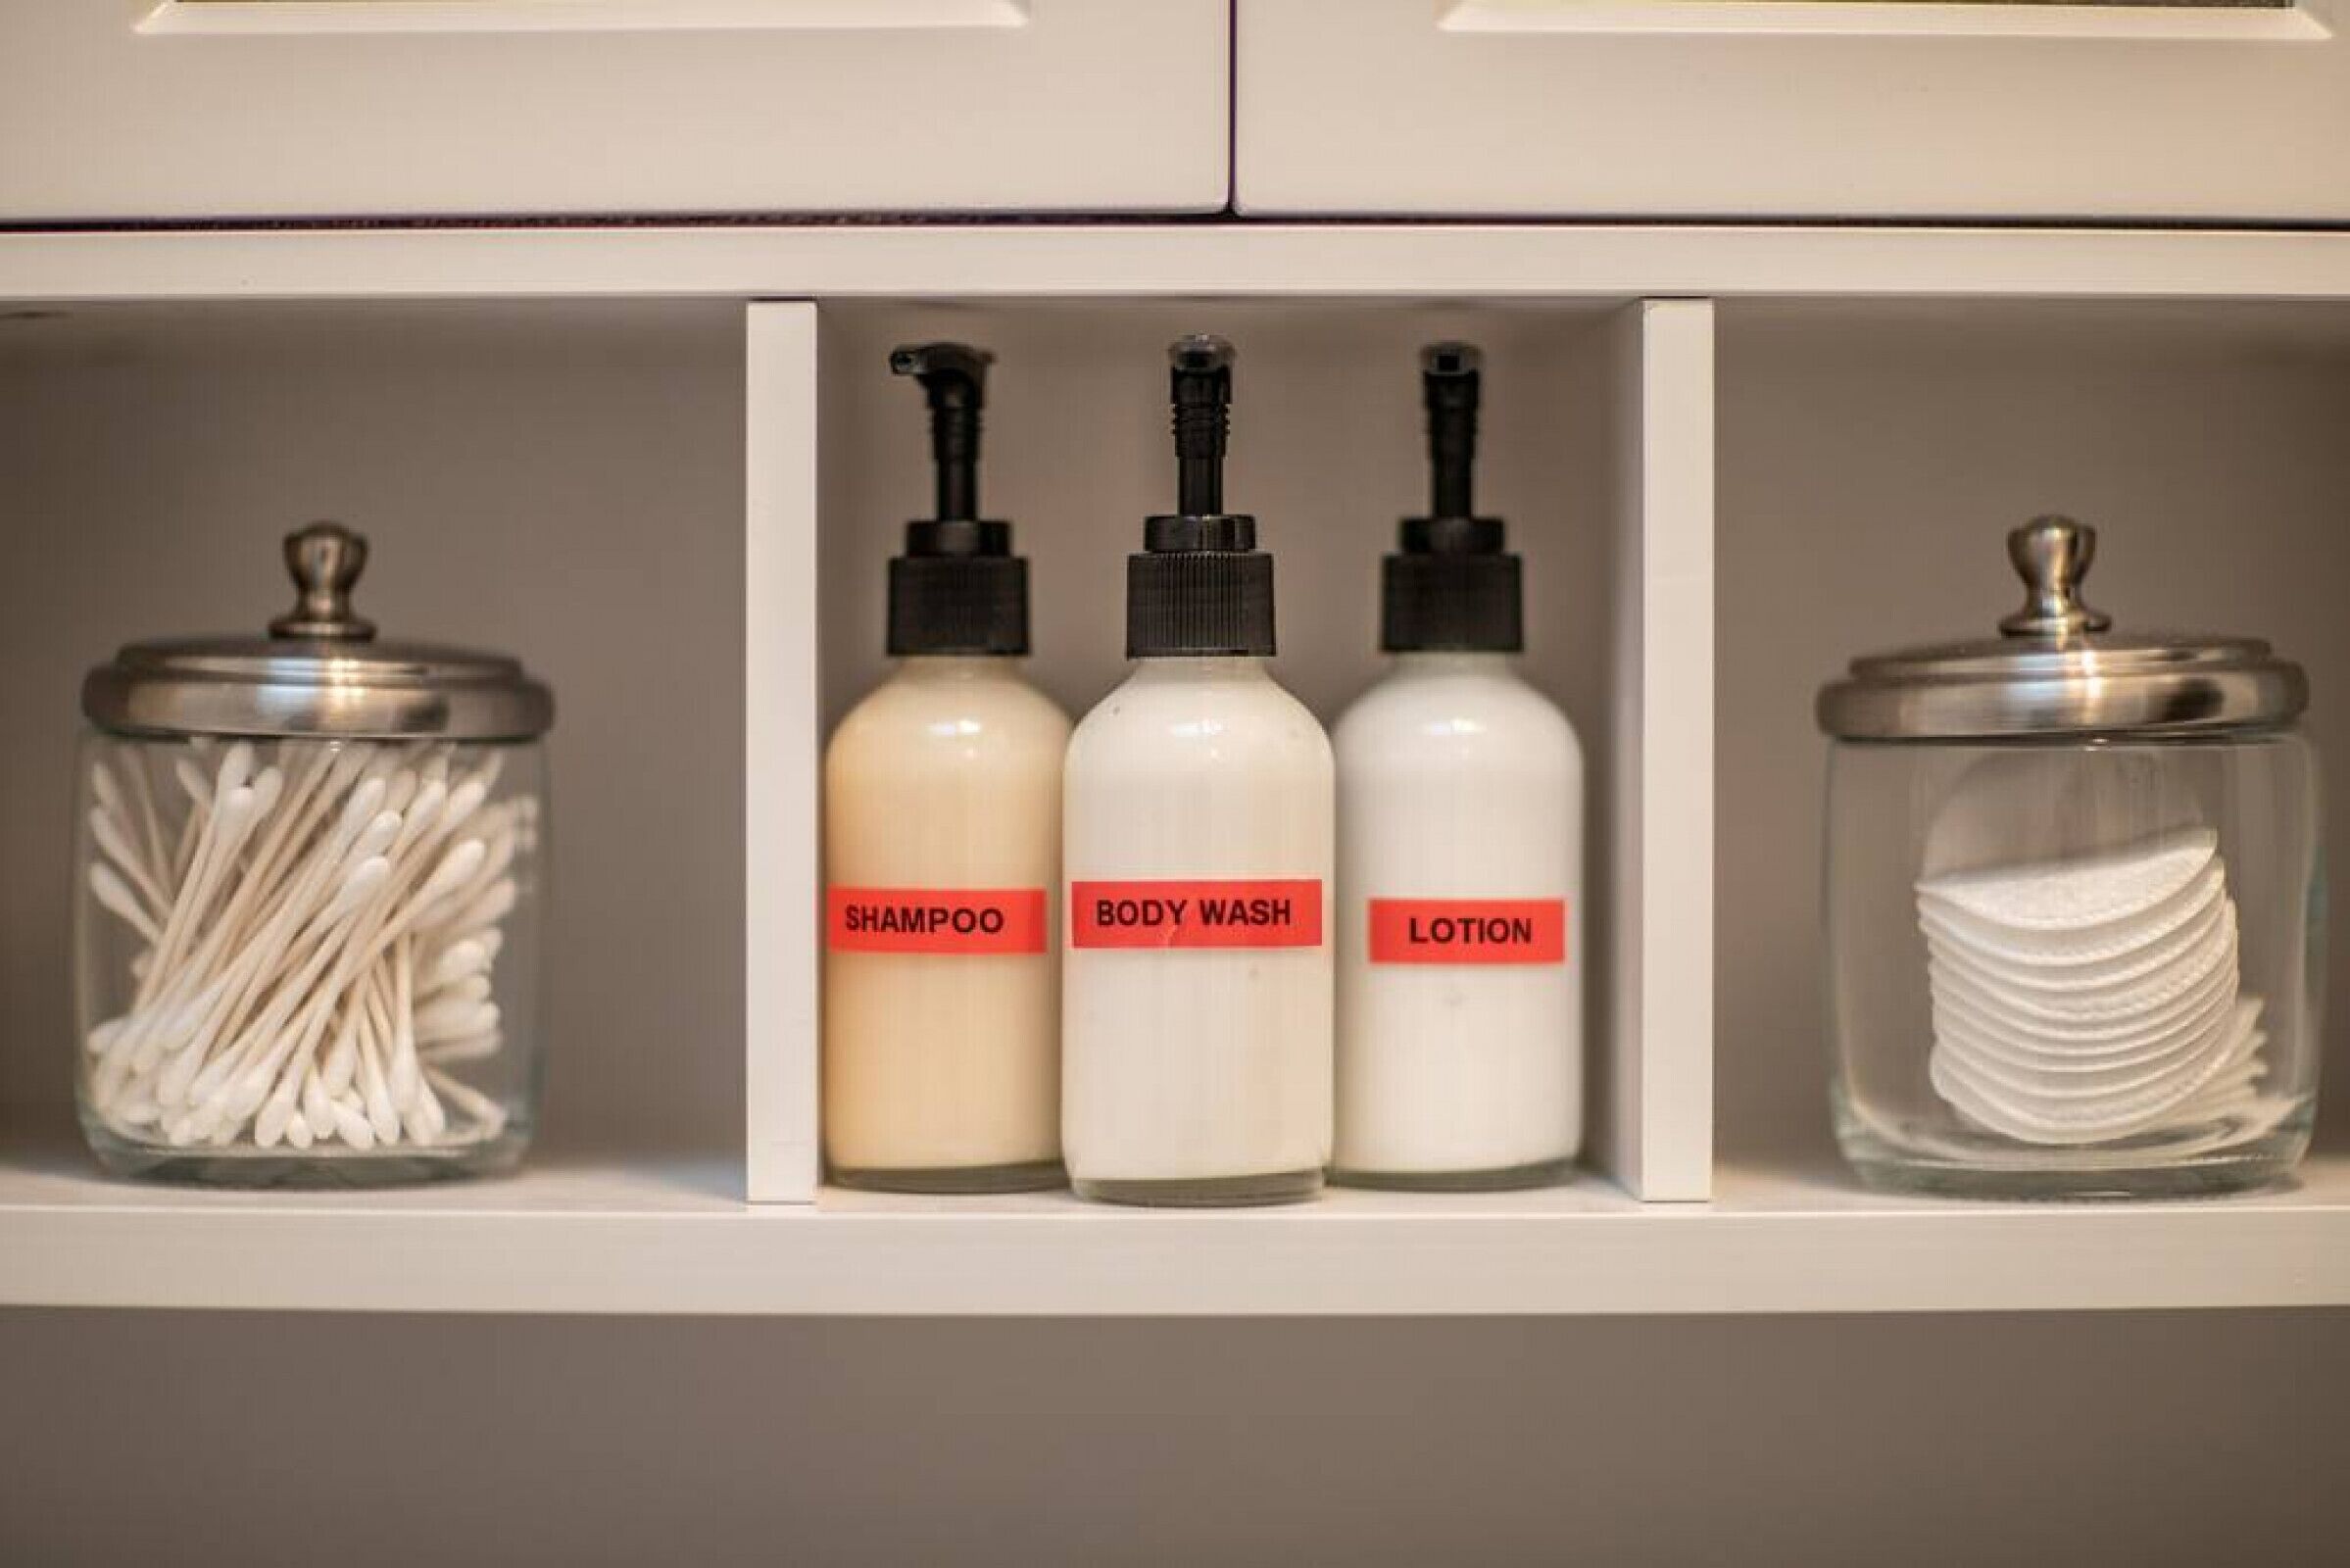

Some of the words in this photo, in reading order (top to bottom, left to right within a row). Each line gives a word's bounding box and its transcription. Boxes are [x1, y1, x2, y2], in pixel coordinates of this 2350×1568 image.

[845, 904, 1004, 935] SHAMPOO
[1096, 898, 1188, 928] BODY
[1199, 898, 1293, 926] WASH
[1408, 915, 1533, 945] LOTION
